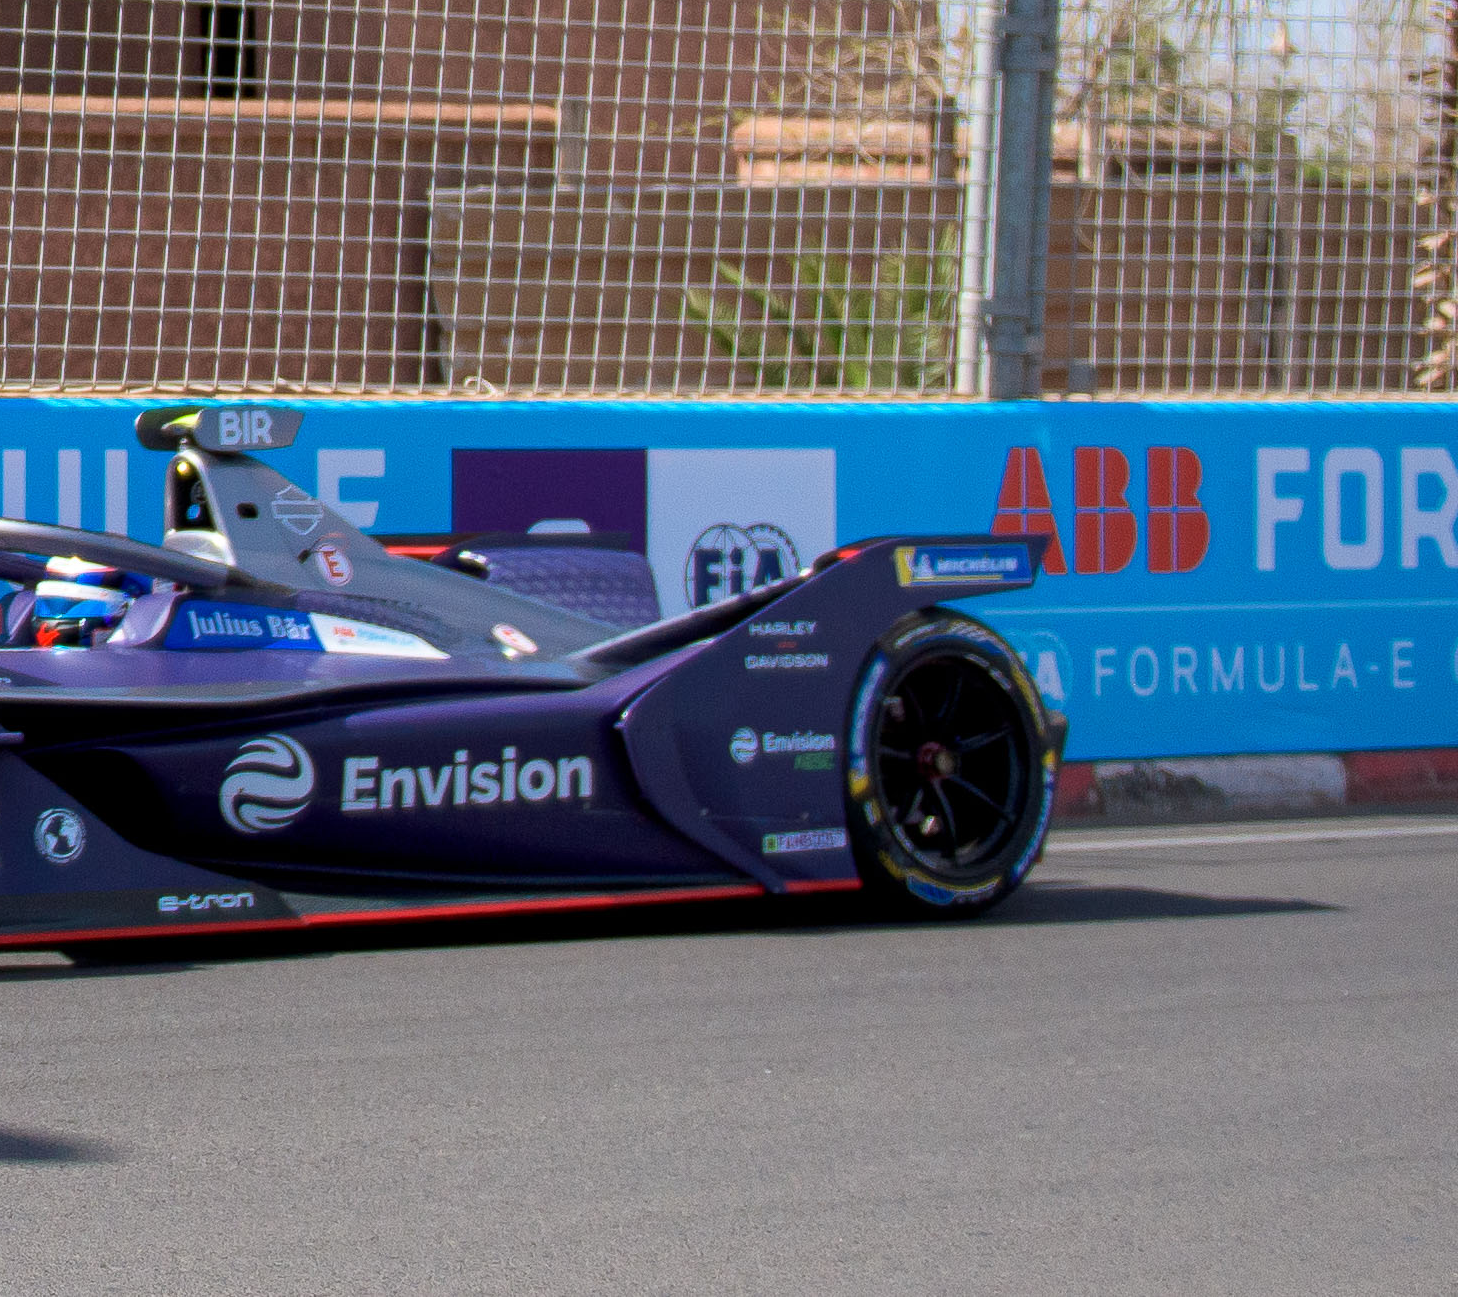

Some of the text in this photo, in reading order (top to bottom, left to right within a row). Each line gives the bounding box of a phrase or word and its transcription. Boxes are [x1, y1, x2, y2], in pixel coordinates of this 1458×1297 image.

[219, 410, 273, 446] BIR
[991, 447, 1458, 574] ABB FOR
[936, 557, 1018, 574] MICHELIN
[187, 610, 263, 640] Julius
[266, 614, 311, 640] Bär
[1093, 639, 1416, 697] FORMULA-E
[340, 745, 593, 812] Envision
[158, 893, 255, 912] e-tron
